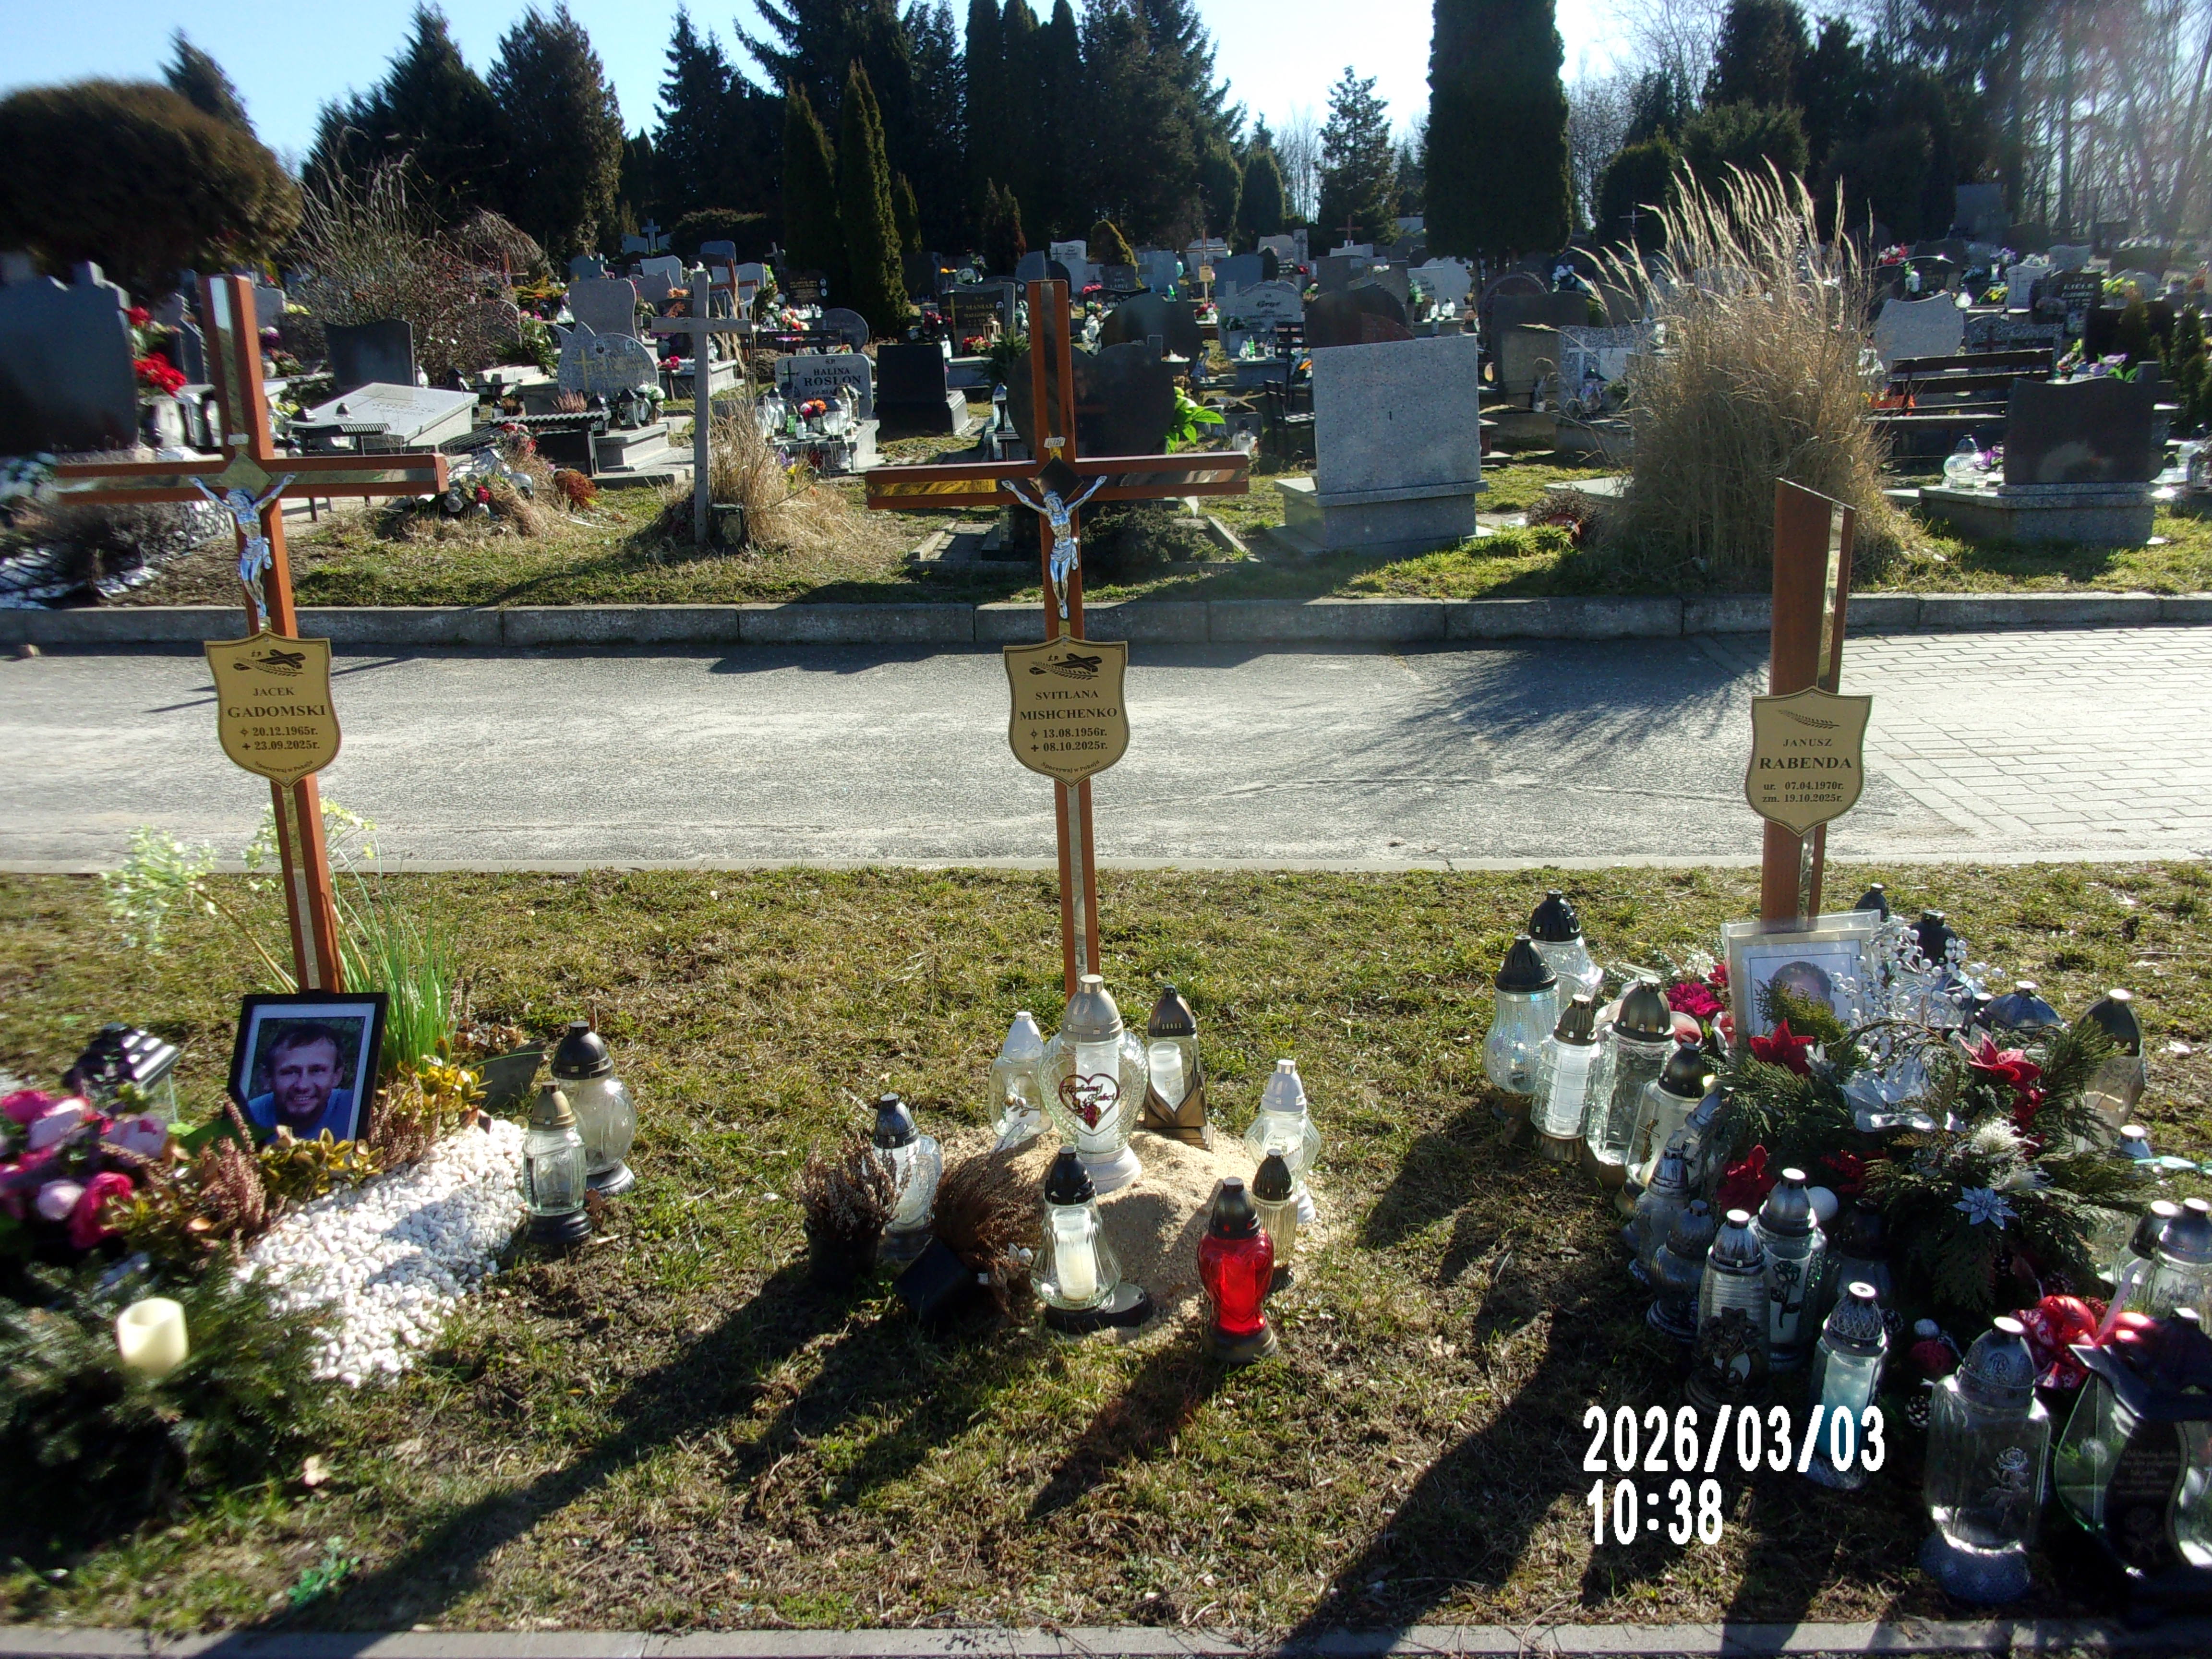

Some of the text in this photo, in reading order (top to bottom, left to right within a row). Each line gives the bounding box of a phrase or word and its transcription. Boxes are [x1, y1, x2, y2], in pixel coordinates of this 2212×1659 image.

[814, 368, 850, 376] HALINA
[253, 687, 295, 696] JACEK
[1035, 690, 1099, 700] SVITLANA
[228, 705, 326, 718] GADOMSKI
[1020, 708, 1118, 721] MISHCHENKO
[252, 726, 318, 736] 20.12.1965r.
[1043, 728, 1107, 738] 13.08.1956r.
[255, 741, 320, 751] 23.09.2025r.
[1043, 741, 1108, 752] 08.10.2025r.
[1783, 738, 1832, 747] JANUSZ
[1759, 757, 1852, 769] RABENDA
[1785, 781, 1844, 790] 07.04.1970r.
[1784, 794, 1843, 803] 19.10.2025r.
